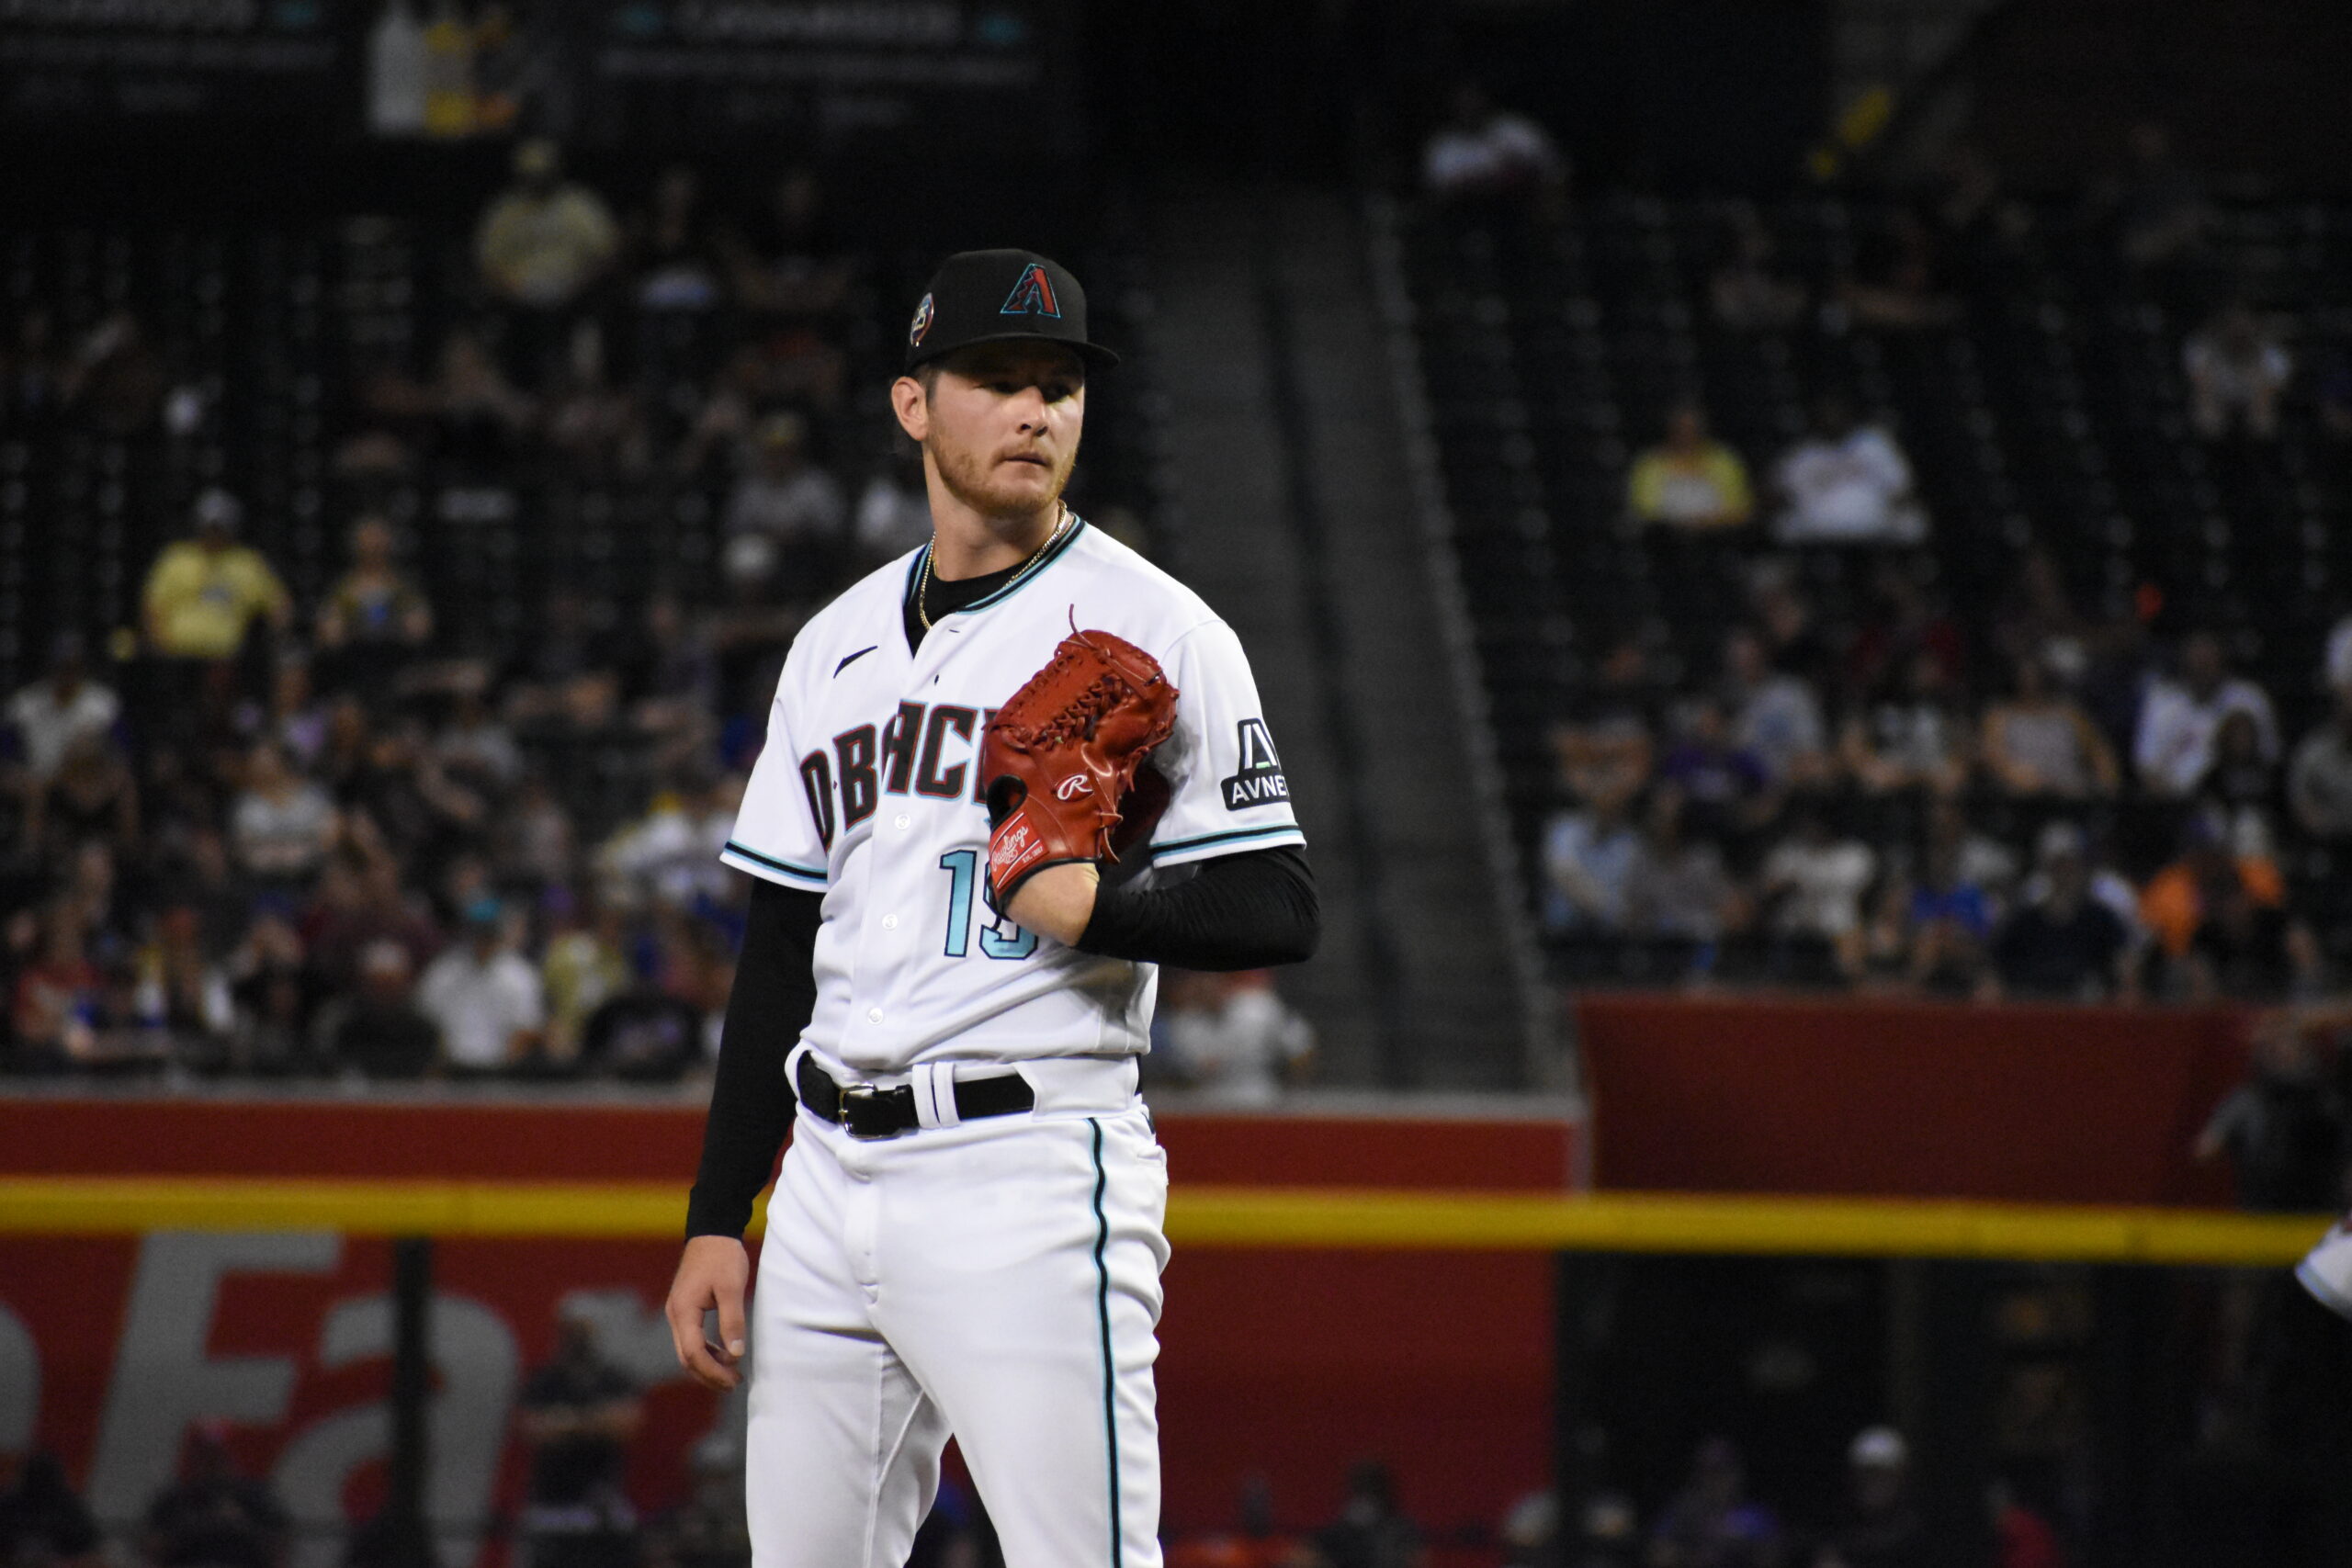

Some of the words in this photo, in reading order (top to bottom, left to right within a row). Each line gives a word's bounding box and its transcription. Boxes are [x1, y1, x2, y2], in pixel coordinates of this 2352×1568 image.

[1000, 263, 1061, 318] A
[1057, 774, 1093, 800] R
[1232, 774, 1289, 805] AVNE
[991, 826, 1029, 872] Rawlings
